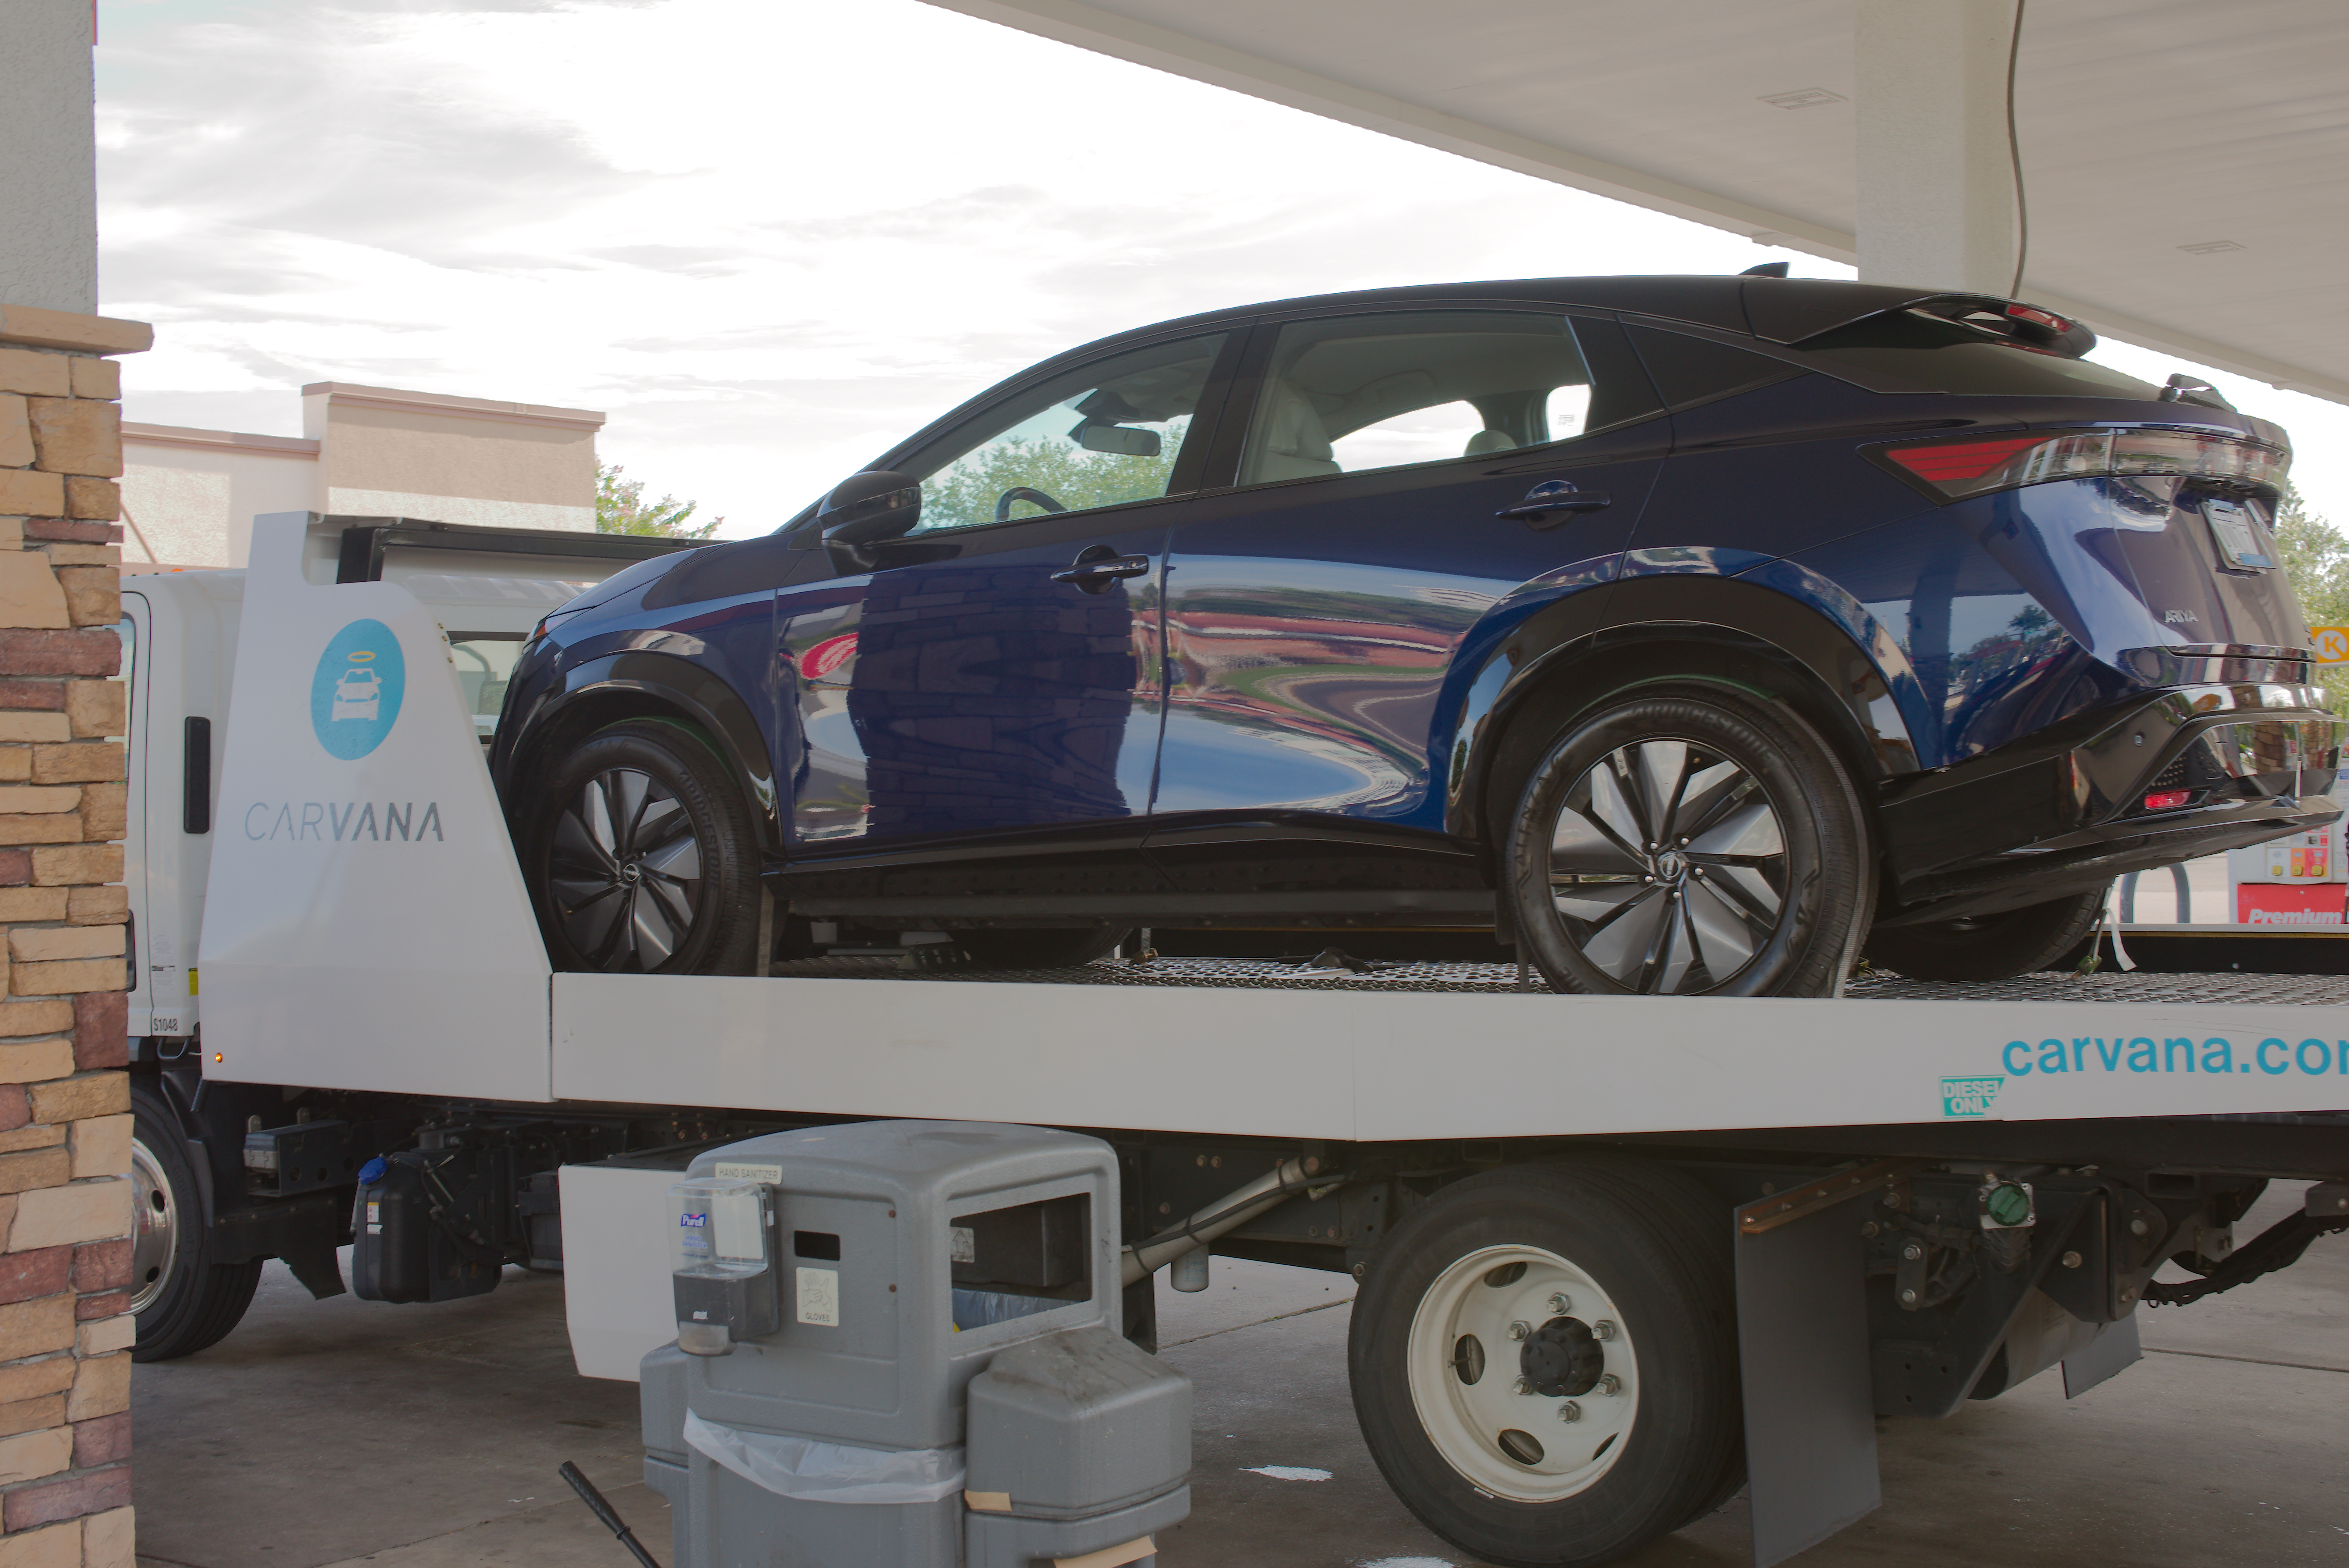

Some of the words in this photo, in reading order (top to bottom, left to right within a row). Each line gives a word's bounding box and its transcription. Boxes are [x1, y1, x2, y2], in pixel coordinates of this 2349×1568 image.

[2324, 636, 2344, 656] K
[244, 802, 444, 842] CARVANA
[677, 770, 721, 892] BRIDGESTONE
[2247, 908, 2343, 924] Premium
[2002, 1036, 2349, 1077] carvana.co
[718, 1167, 739, 1178] HAND
[741, 1169, 778, 1179] SANITIZER
[682, 1214, 704, 1227] Purell
[806, 1312, 830, 1322] GLOVES
